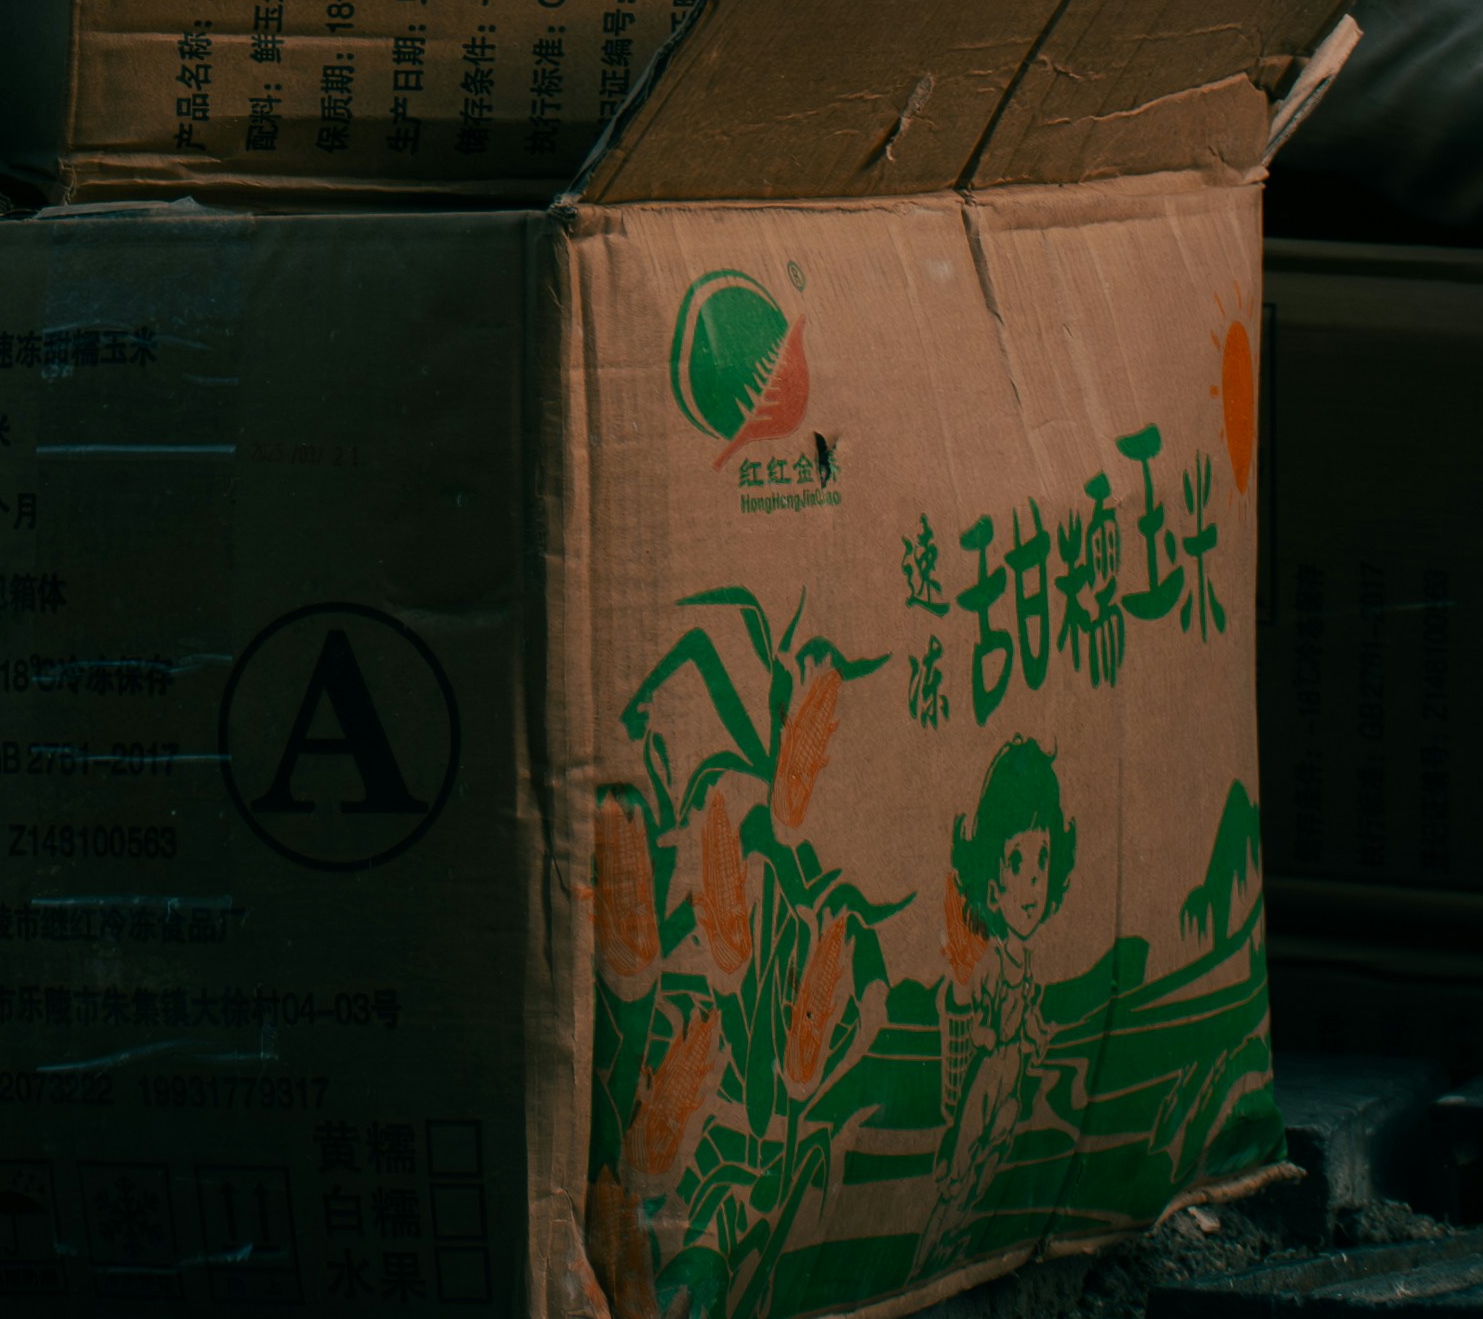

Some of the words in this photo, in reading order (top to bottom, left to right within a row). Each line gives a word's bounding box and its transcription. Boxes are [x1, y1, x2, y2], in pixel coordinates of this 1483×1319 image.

[956, 422, 1227, 727] 甜糯玉米
[250, 629, 430, 814] A
[137, 1075, 331, 1111] 19931779317
[313, 1120, 418, 1175] 黄糯
[321, 1185, 422, 1240] 白糯
[327, 1246, 428, 1303] 水果
